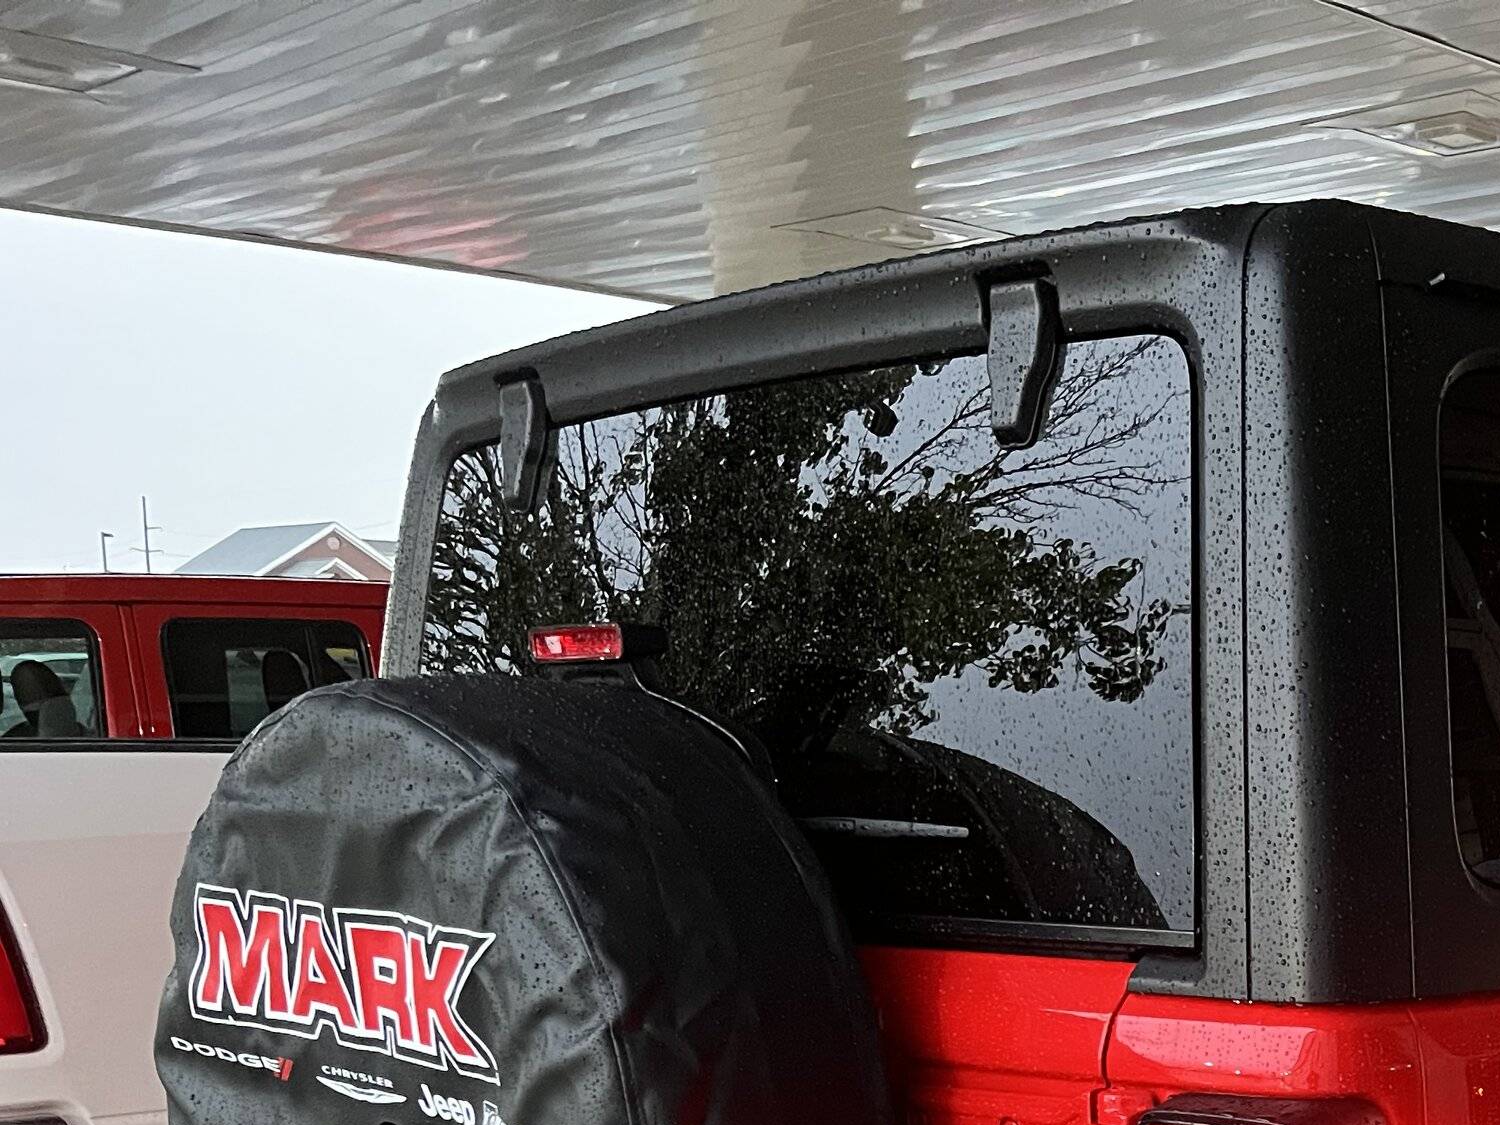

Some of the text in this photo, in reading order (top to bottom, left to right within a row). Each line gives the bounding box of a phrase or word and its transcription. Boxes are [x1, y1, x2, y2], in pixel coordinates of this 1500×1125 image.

[190, 884, 501, 1085] MARK
[170, 1036, 283, 1074] DODGE
[320, 1064, 394, 1089] CHRYSLER
